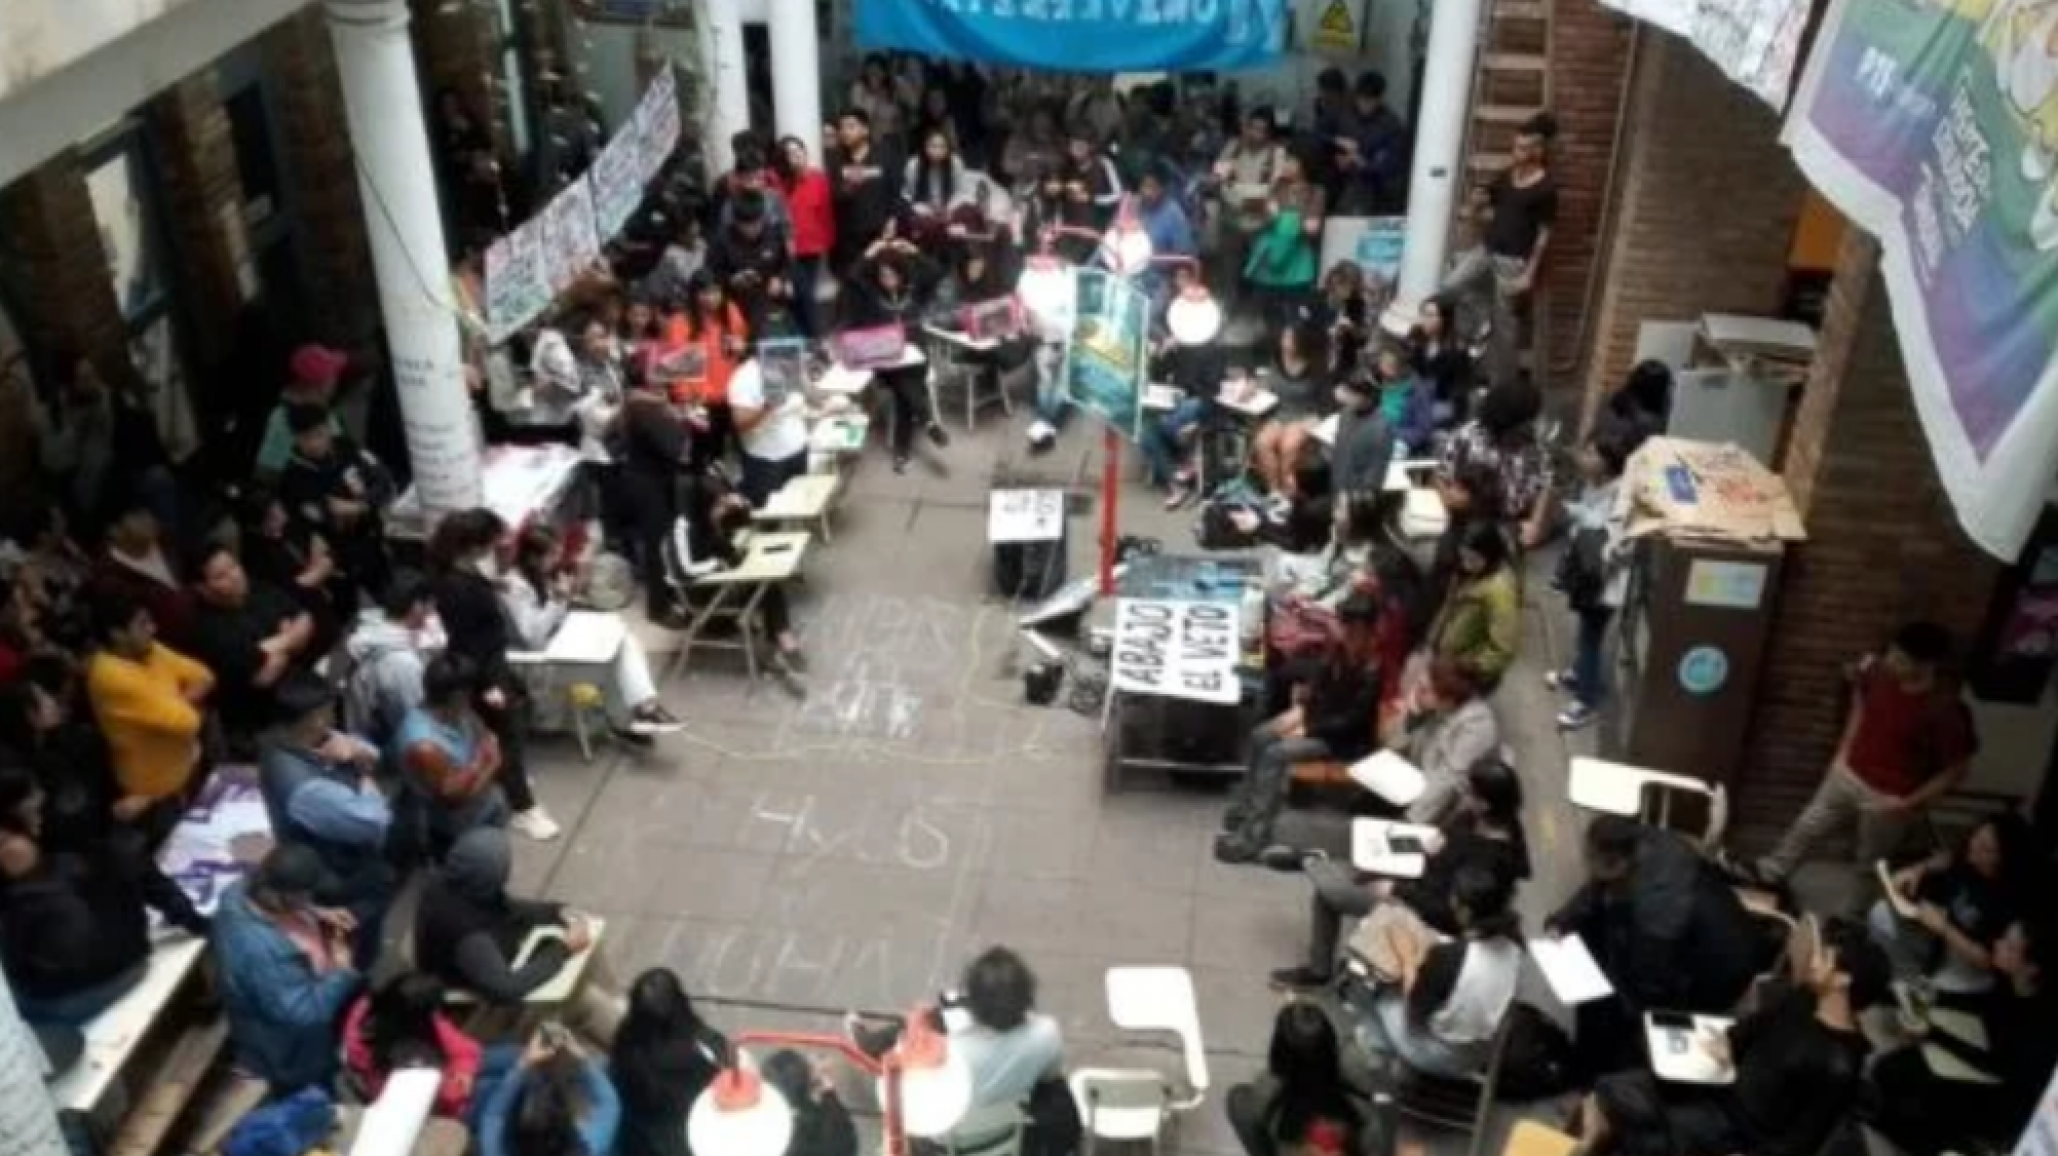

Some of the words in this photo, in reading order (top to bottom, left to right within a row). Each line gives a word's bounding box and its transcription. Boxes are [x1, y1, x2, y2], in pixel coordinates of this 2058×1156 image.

[1117, 604, 1173, 686] ABAJO
[1181, 605, 1231, 660] VETO
[1181, 669, 1222, 692] EL
